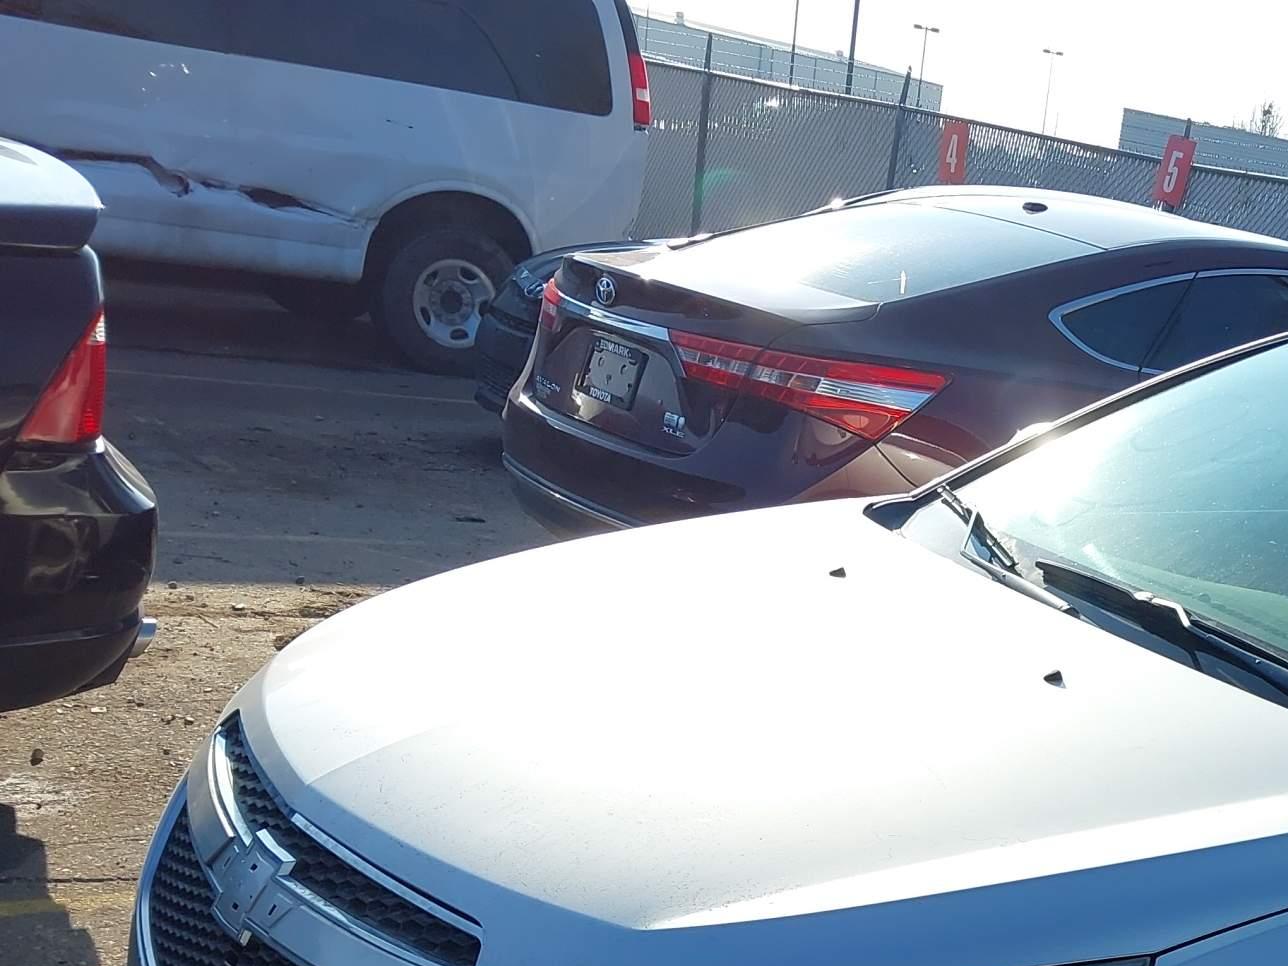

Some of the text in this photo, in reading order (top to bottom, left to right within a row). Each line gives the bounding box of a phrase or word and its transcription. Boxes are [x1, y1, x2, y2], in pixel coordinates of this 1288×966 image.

[946, 134, 958, 173] 4
[1163, 150, 1184, 193] 5
[589, 387, 611, 403] TOYOTA
[662, 426, 685, 438] XLE
